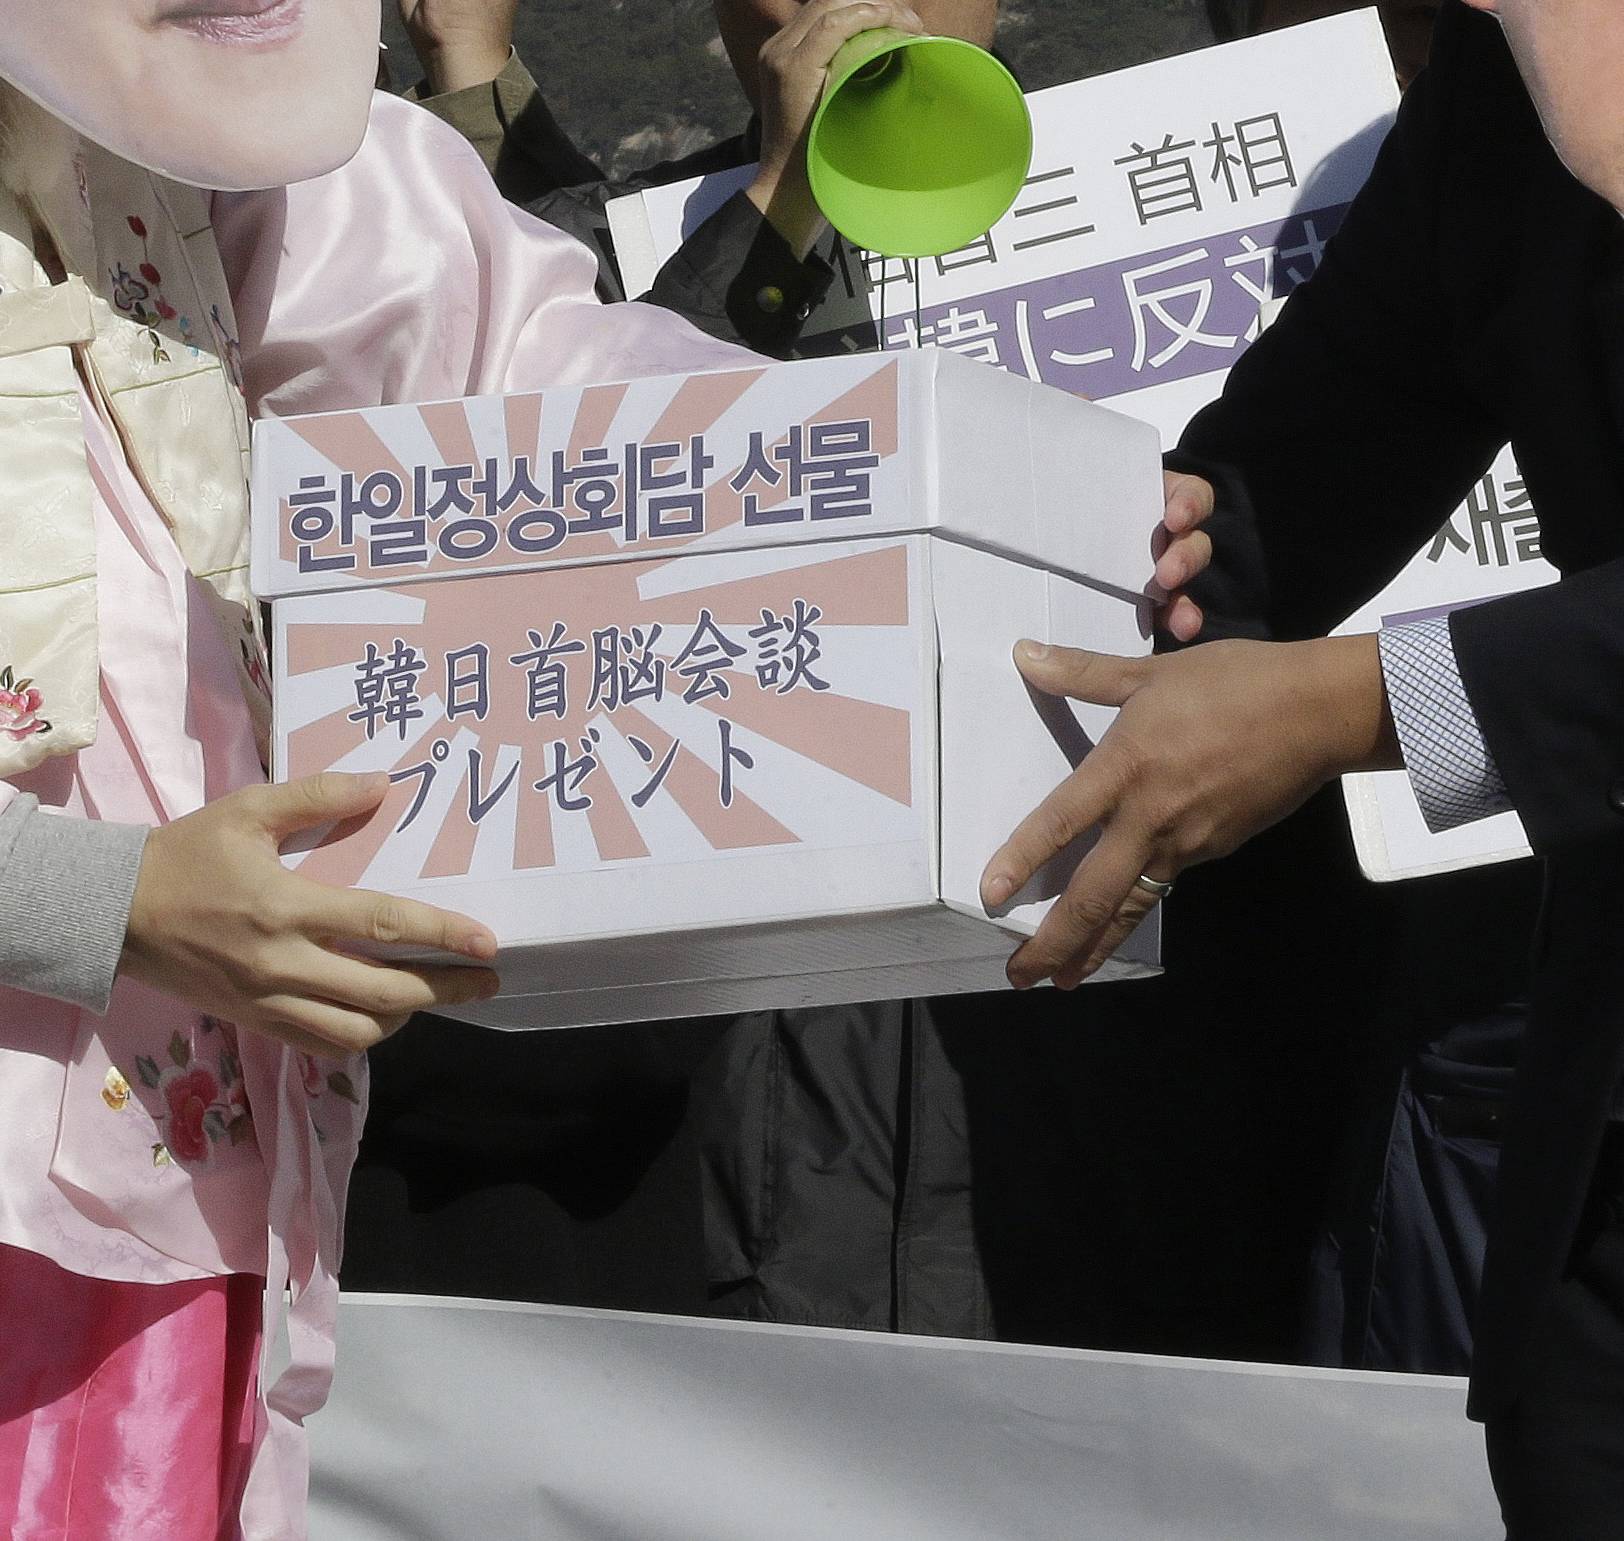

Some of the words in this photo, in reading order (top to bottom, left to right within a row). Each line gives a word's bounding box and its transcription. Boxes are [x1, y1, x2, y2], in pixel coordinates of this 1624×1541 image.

[1114, 111, 1298, 226] 首相
[288, 434, 714, 573] 한일정상회담
[729, 418, 881, 528] 선물
[349, 599, 832, 742] 韓日首脳会談
[388, 718, 758, 835] プレゼント
